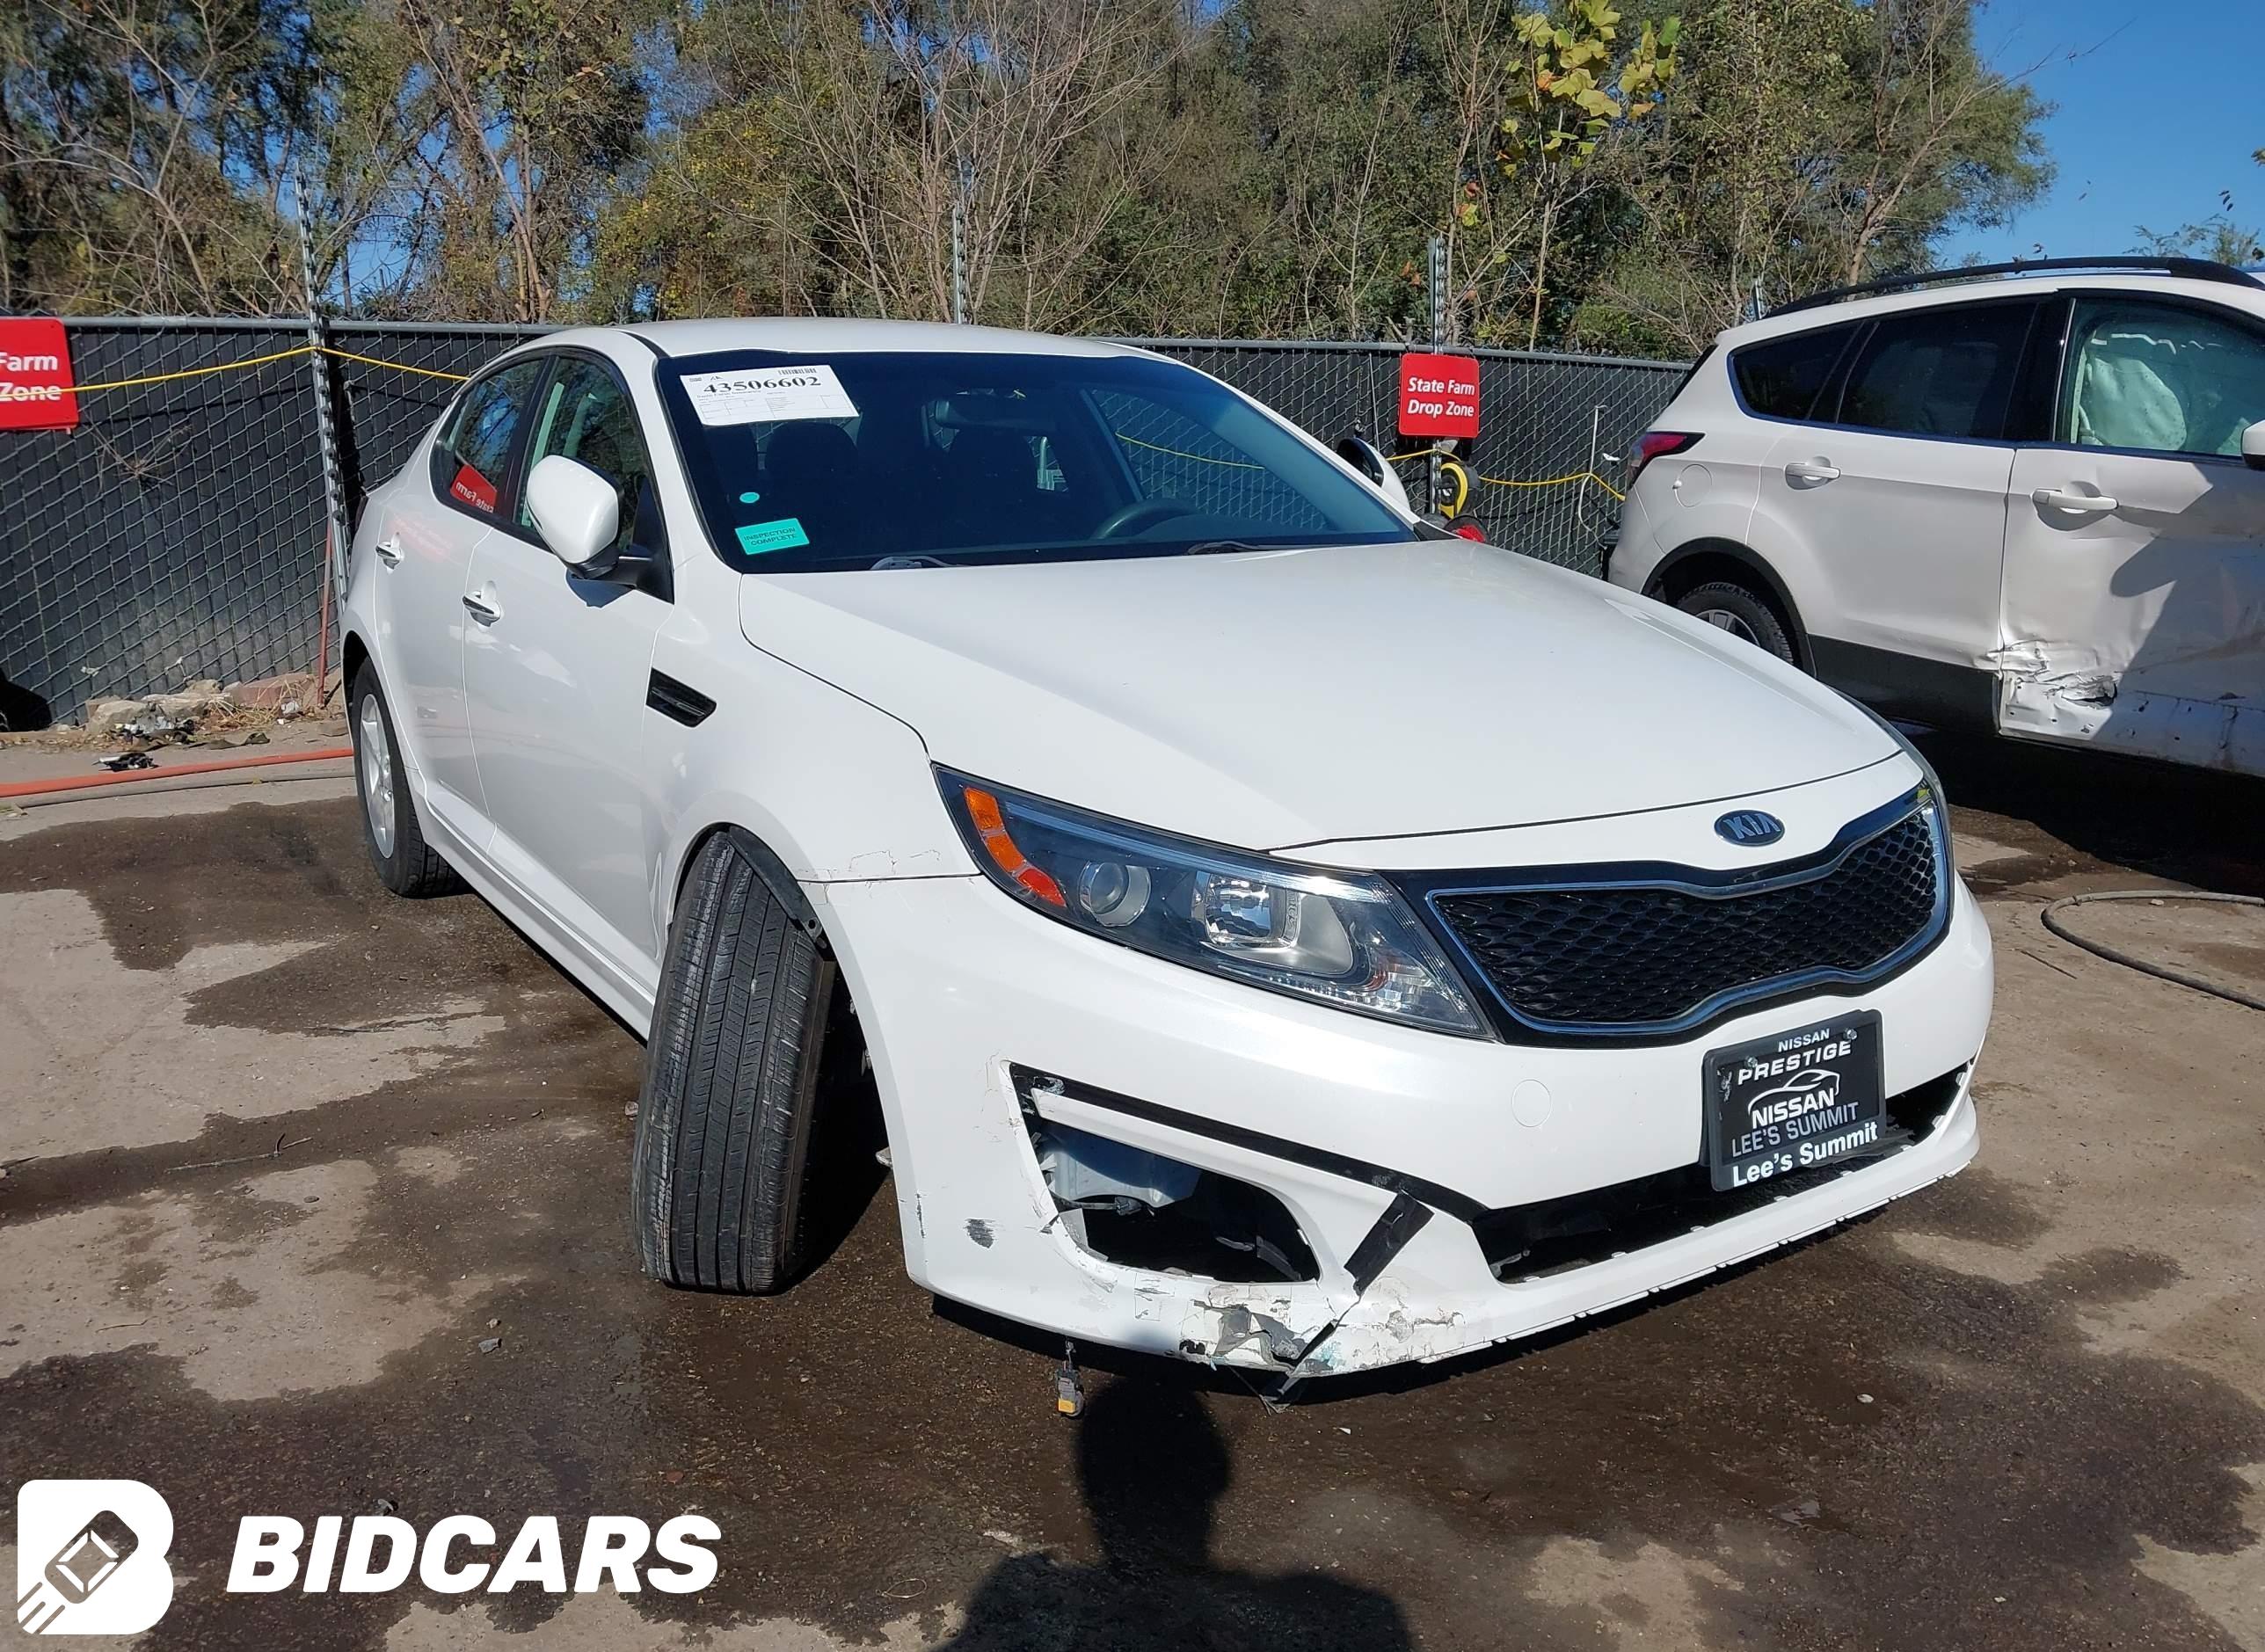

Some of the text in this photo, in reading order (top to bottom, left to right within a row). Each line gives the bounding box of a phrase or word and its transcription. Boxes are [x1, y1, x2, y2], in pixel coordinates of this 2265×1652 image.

[703, 375, 822, 394] 43506602
[1407, 376, 1475, 396] State Farm
[1407, 399, 1475, 418] Drop Zone
[744, 527, 796, 542] INSPECTION
[750, 533, 797, 546] COMPLETE
[1722, 812, 1781, 840] KIA
[1778, 1028, 1831, 1052] NISSAN
[1737, 1039, 1852, 1086] PRESTIGE
[1752, 1088, 1836, 1130] NISSAN
[1731, 1102, 1859, 1158] LEE'S SUMMIT
[1732, 1121, 1878, 1188] Lee's Summit
